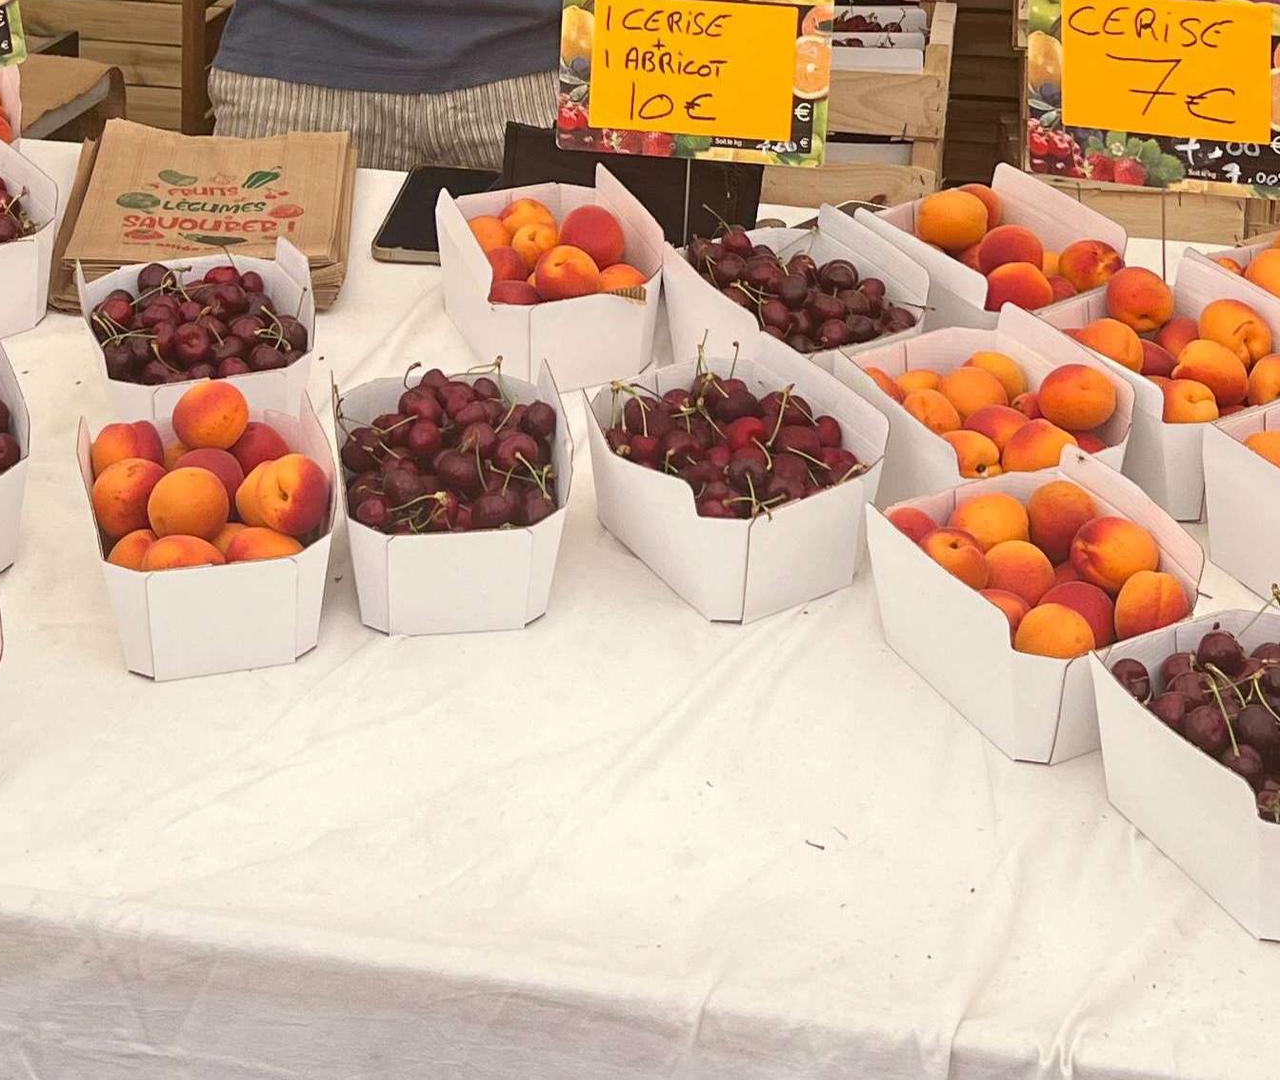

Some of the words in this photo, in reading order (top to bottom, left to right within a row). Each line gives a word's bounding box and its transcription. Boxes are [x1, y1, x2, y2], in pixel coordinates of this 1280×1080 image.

[653, 38, 665, 51] +
[167, 186, 239, 197] FRUITS
[162, 198, 267, 214] LÉGUMES
[122, 215, 278, 233] SAVOURER
